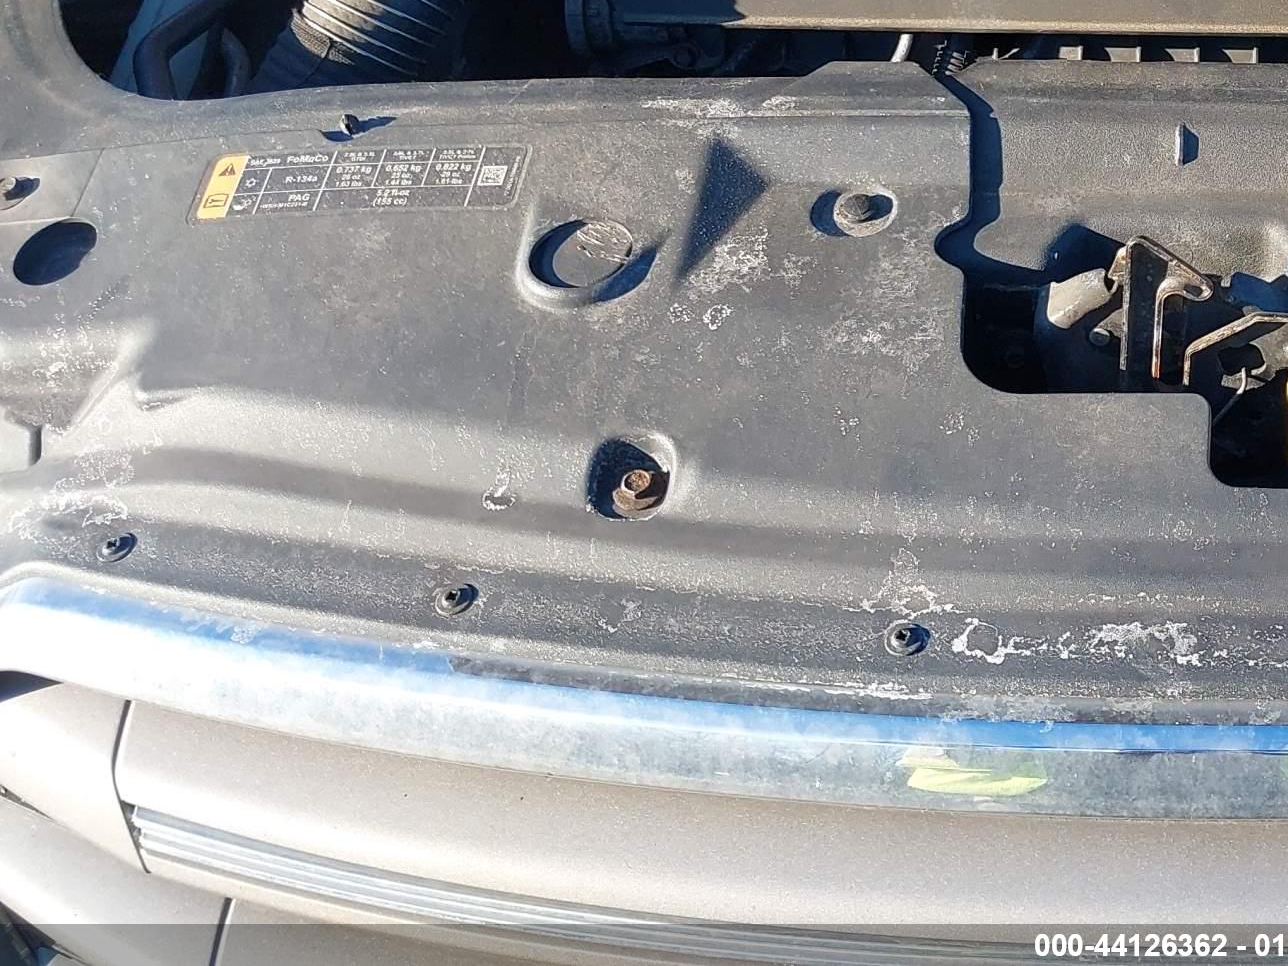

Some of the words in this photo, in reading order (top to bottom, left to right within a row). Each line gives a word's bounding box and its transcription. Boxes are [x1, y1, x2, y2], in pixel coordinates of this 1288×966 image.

[336, 166, 360, 174] 0.737
[360, 166, 373, 175] kg
[385, 164, 409, 172] 0.652
[410, 164, 422, 173] kg
[435, 163, 459, 171] 0.822
[460, 163, 472, 172] kg
[285, 175, 318, 184] R-134a
[288, 194, 311, 202] PAG
[372, 197, 392, 207] (155
[393, 197, 408, 206] cc)
